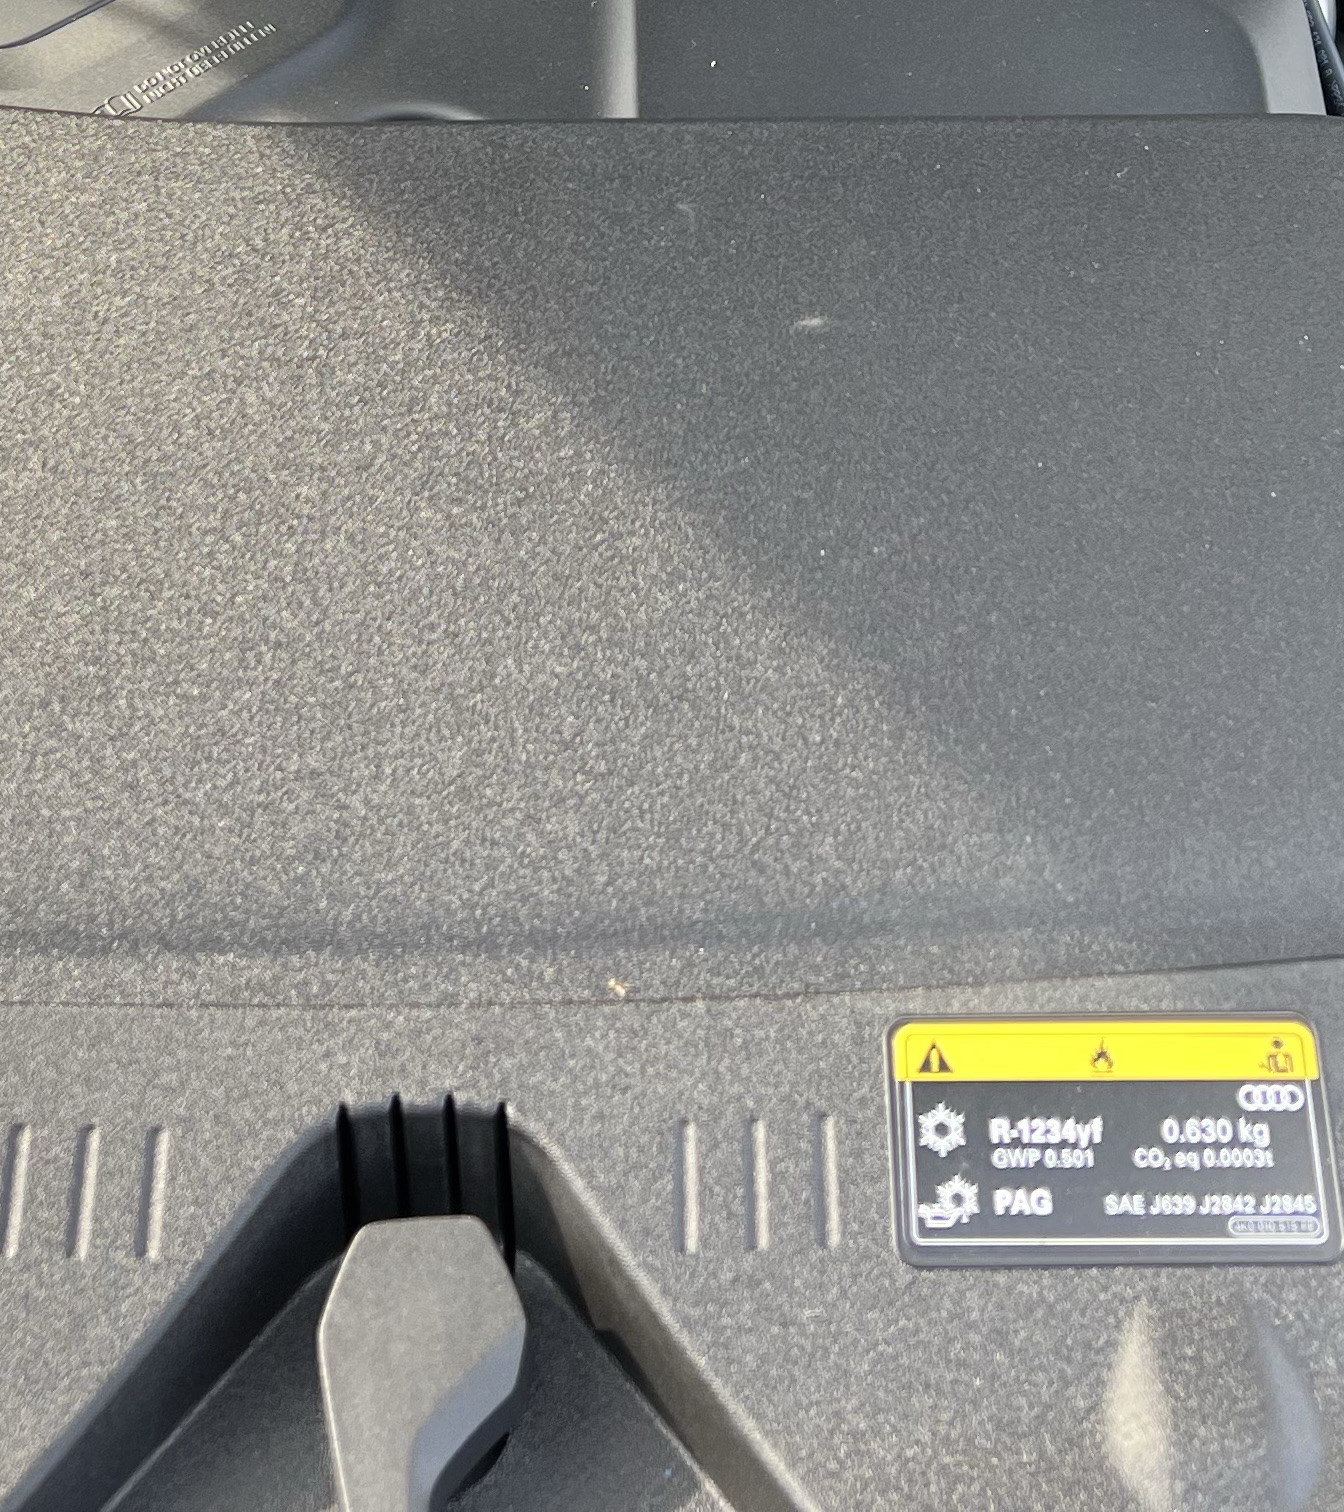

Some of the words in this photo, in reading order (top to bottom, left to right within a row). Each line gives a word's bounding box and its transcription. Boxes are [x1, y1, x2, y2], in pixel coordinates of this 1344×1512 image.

[989, 1116, 1104, 1149] R-1234yf
[1161, 1116, 1233, 1144] 0.630
[1238, 1116, 1271, 1148] kg
[991, 1147, 1041, 1169] GWP
[1043, 1147, 1095, 1169] 0.501
[1174, 1151, 1201, 1172] eq
[1203, 1148, 1275, 1169] 0.0003t
[993, 1187, 1053, 1216] PAG
[1104, 1193, 1147, 1216] SAE
[1150, 1193, 1197, 1216] J639
[1200, 1193, 1257, 1216] J2842
[1260, 1193, 1317, 1216] J2845
